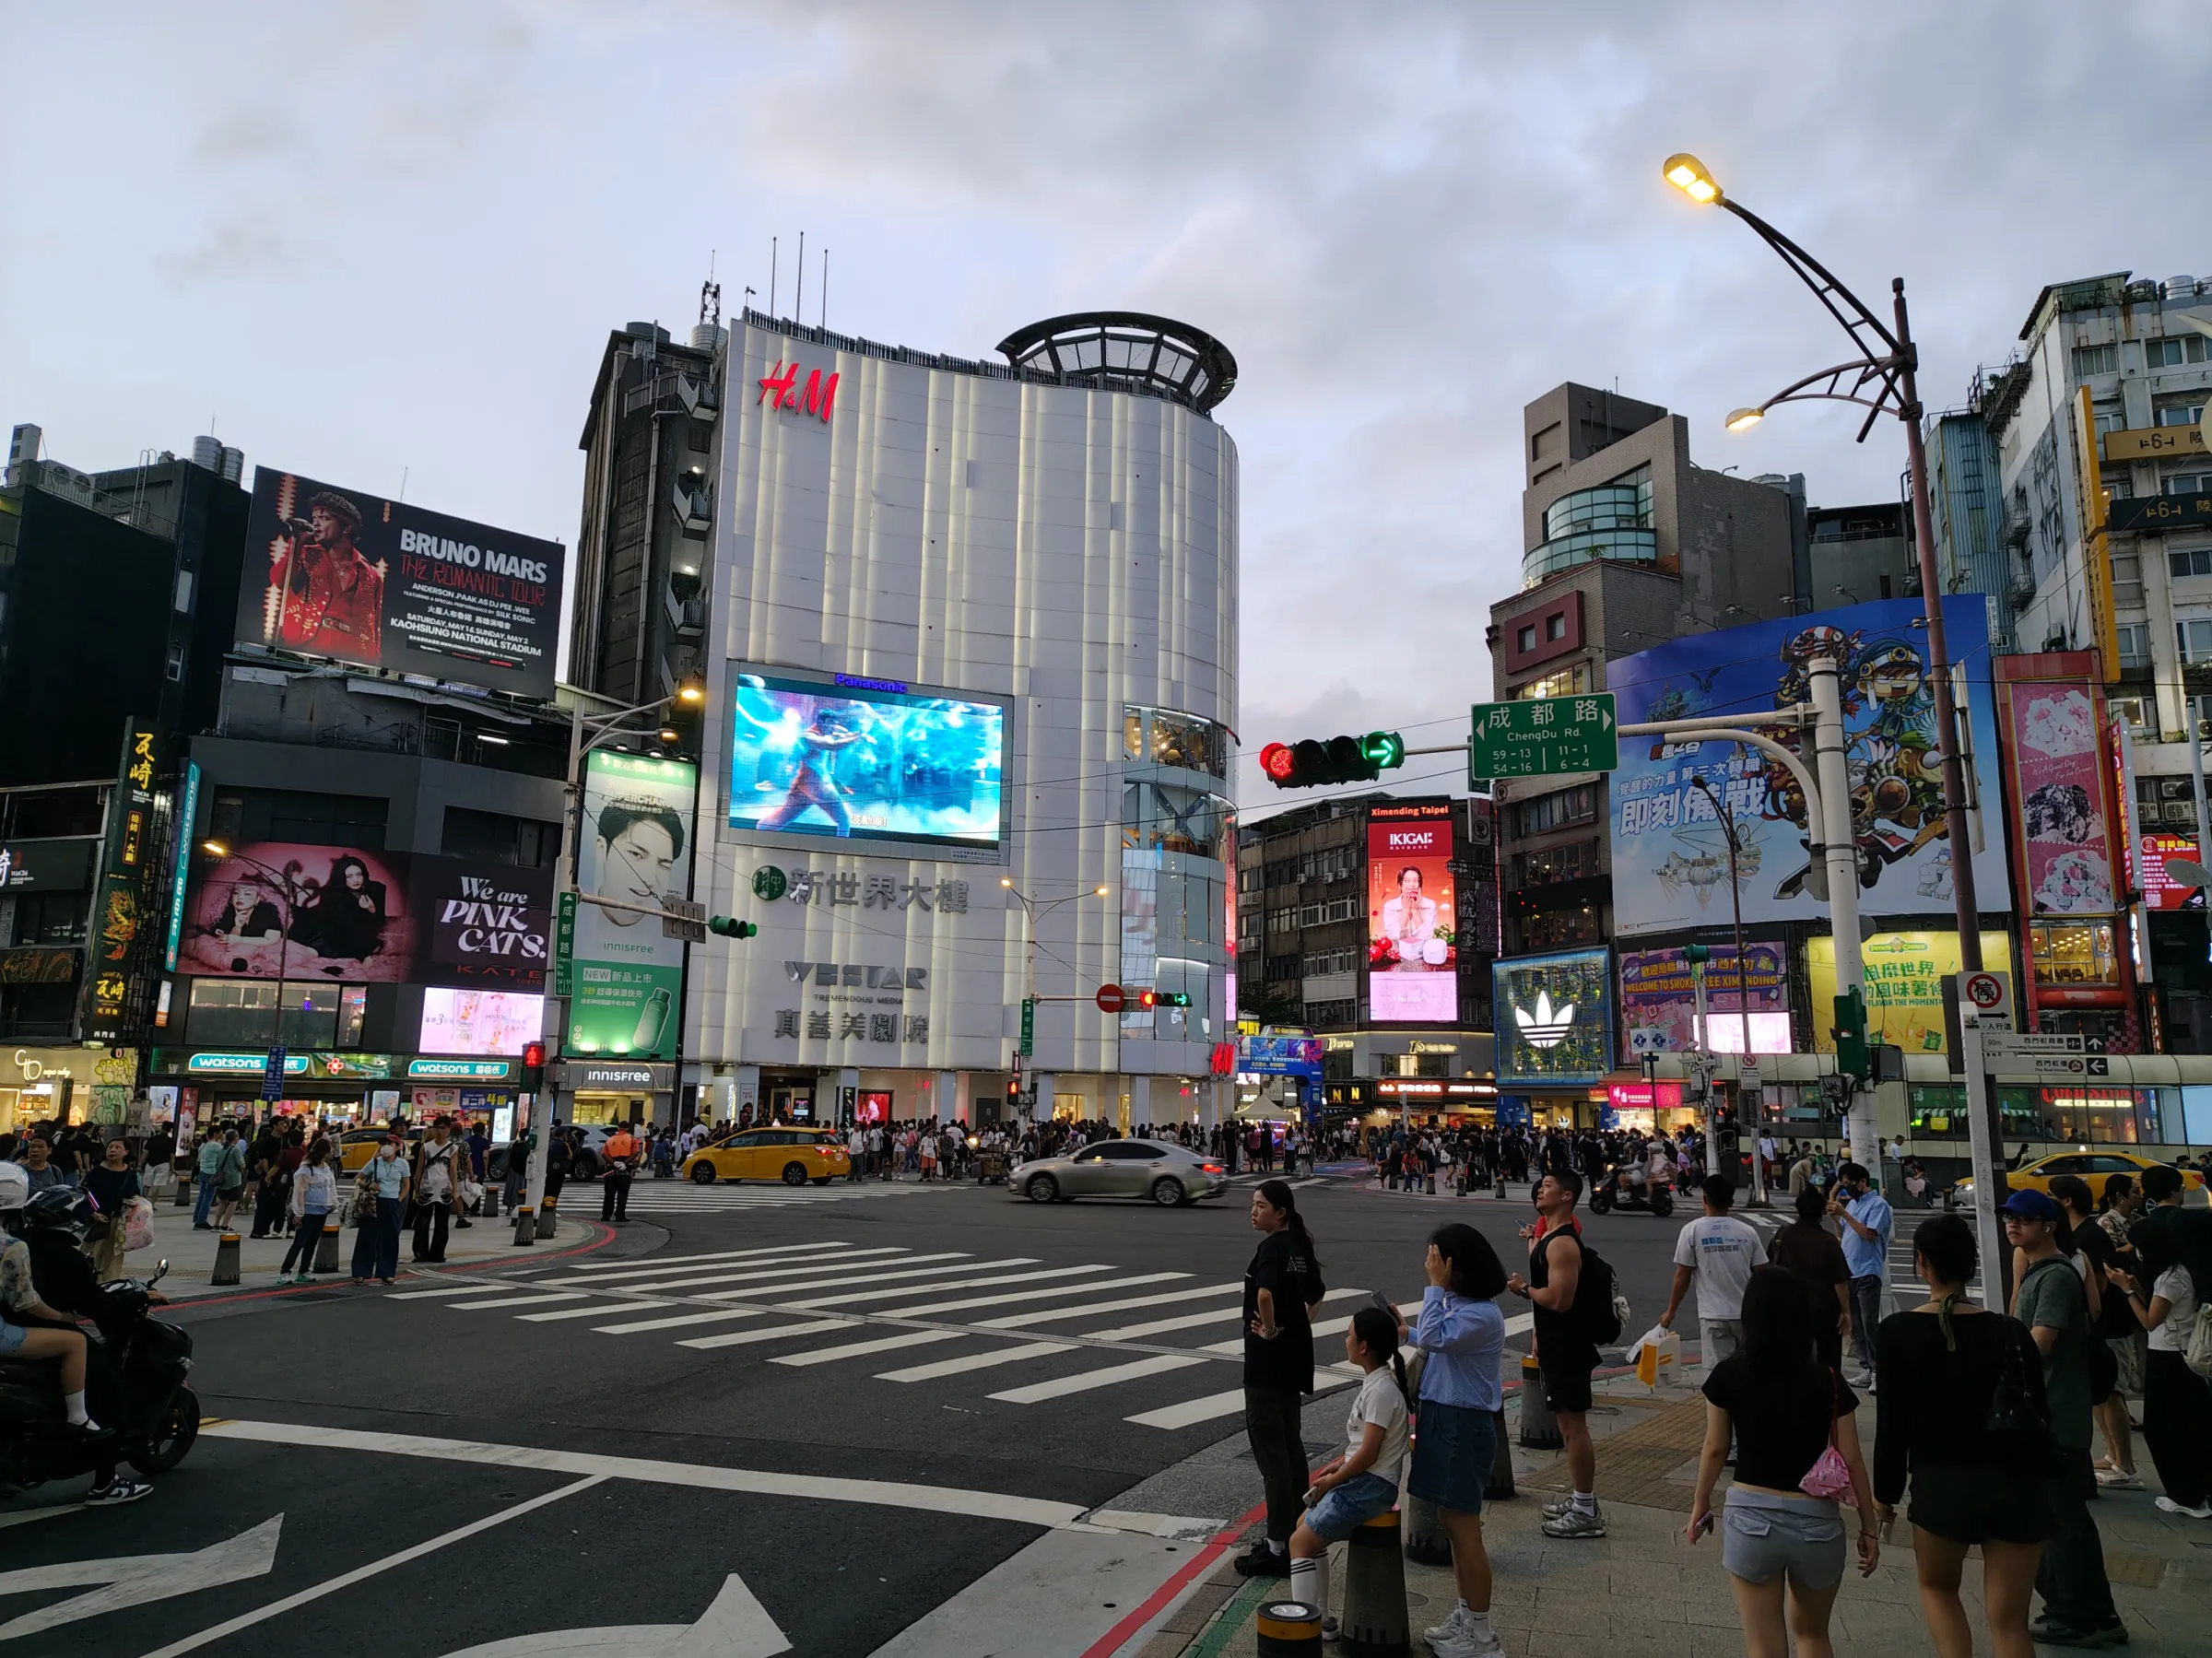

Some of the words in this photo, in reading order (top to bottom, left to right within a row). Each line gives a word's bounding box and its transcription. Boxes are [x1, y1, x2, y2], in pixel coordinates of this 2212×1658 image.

[758, 359, 840, 423] H&M
[400, 528, 480, 568] BRUNO
[485, 549, 547, 583] MARS
[401, 553, 429, 581] THE
[432, 561, 505, 598] ROMANTIC
[510, 580, 547, 607] TOUR
[403, 591, 430, 602] FEATURING
[434, 596, 453, 606] SPECIAL
[453, 601, 488, 614] PERFORMANCE
[496, 609, 511, 619] SILK
[512, 613, 535, 625] SONIC
[412, 582, 454, 598] ANDERSON
[478, 597, 488, 606] AS
[489, 599, 500, 608] DJ
[500, 602, 512, 611] PEE
[390, 617, 451, 638] KAOHSIUNG
[451, 629, 500, 649] NATIONAL
[500, 640, 542, 657] STADIUM
[406, 613, 448, 629] SATURDAY,
[448, 620, 465, 631] MAY
[476, 627, 506, 640] SUNDAY,
[507, 632, 523, 643] MAY
[835, 673, 908, 694] Panasonic
[1488, 700, 1598, 729] 成都路
[1507, 730, 1557, 743] ChengDu
[1564, 727, 1582, 737] Rd.
[1618, 770, 1677, 796] 覺醒的力量
[1681, 757, 1760, 782] 第三次轉職
[182, 781, 196, 854] watsons
[1371, 807, 1419, 817] Ximending
[1420, 805, 1449, 815] Taipei
[1618, 777, 1766, 838] 即刻備戰
[461, 876, 494, 900] We
[497, 891, 528, 904] are
[787, 867, 970, 914] 新世界大樓
[440, 900, 528, 931] PINK
[559, 905, 572, 954] 成都路
[458, 928, 547, 958] CATS.
[456, 964, 543, 979] KATE
[584, 968, 609, 980] NEW
[611, 971, 653, 984] 新品上市
[782, 959, 927, 991] VESTAR
[1625, 980, 1659, 993] WELCOME
[1659, 979, 1669, 990] TO
[1723, 975, 1778, 988] XIMNDING
[814, 994, 874, 1004] TREMENDOUS
[877, 997, 903, 1005] MEDIA
[1895, 998, 1907, 1006] THE
[1974, 982, 1995, 1001] 停
[774, 1009, 929, 1044] 真善美劇院
[199, 1057, 261, 1069] watsons
[417, 1063, 470, 1074] watsons
